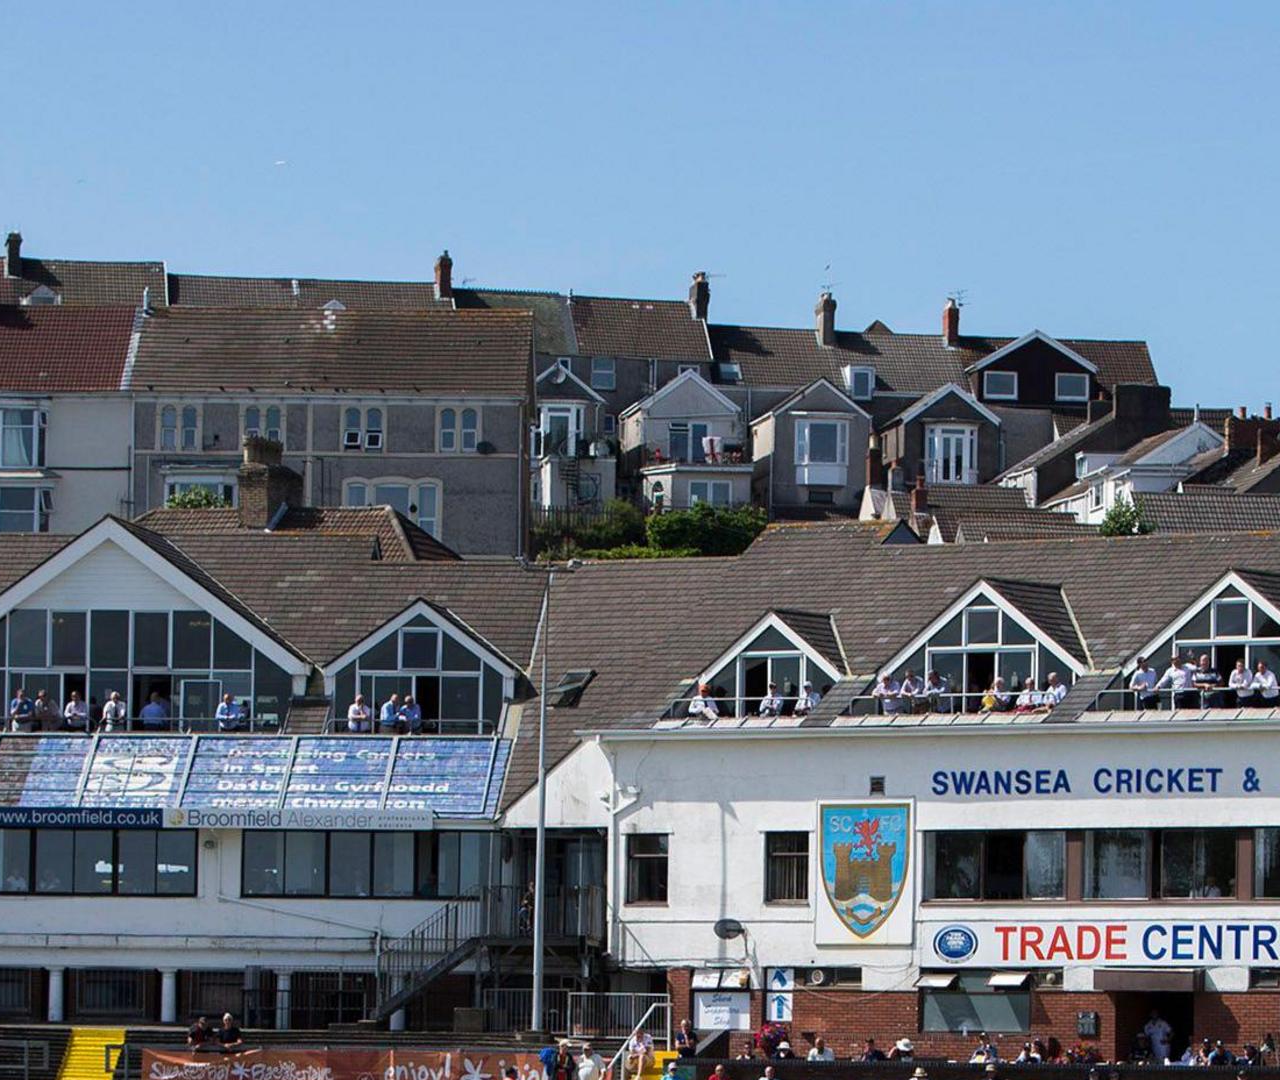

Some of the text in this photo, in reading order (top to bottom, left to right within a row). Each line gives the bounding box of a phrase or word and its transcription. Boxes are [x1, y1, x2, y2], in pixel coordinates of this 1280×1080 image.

[932, 769, 1071, 795] SWANSEA
[1093, 767, 1223, 793] CRICKET
[1242, 767, 1260, 792] &
[188, 810, 373, 828] Broomfield Alexander
[994, 925, 1128, 961] TRADE
